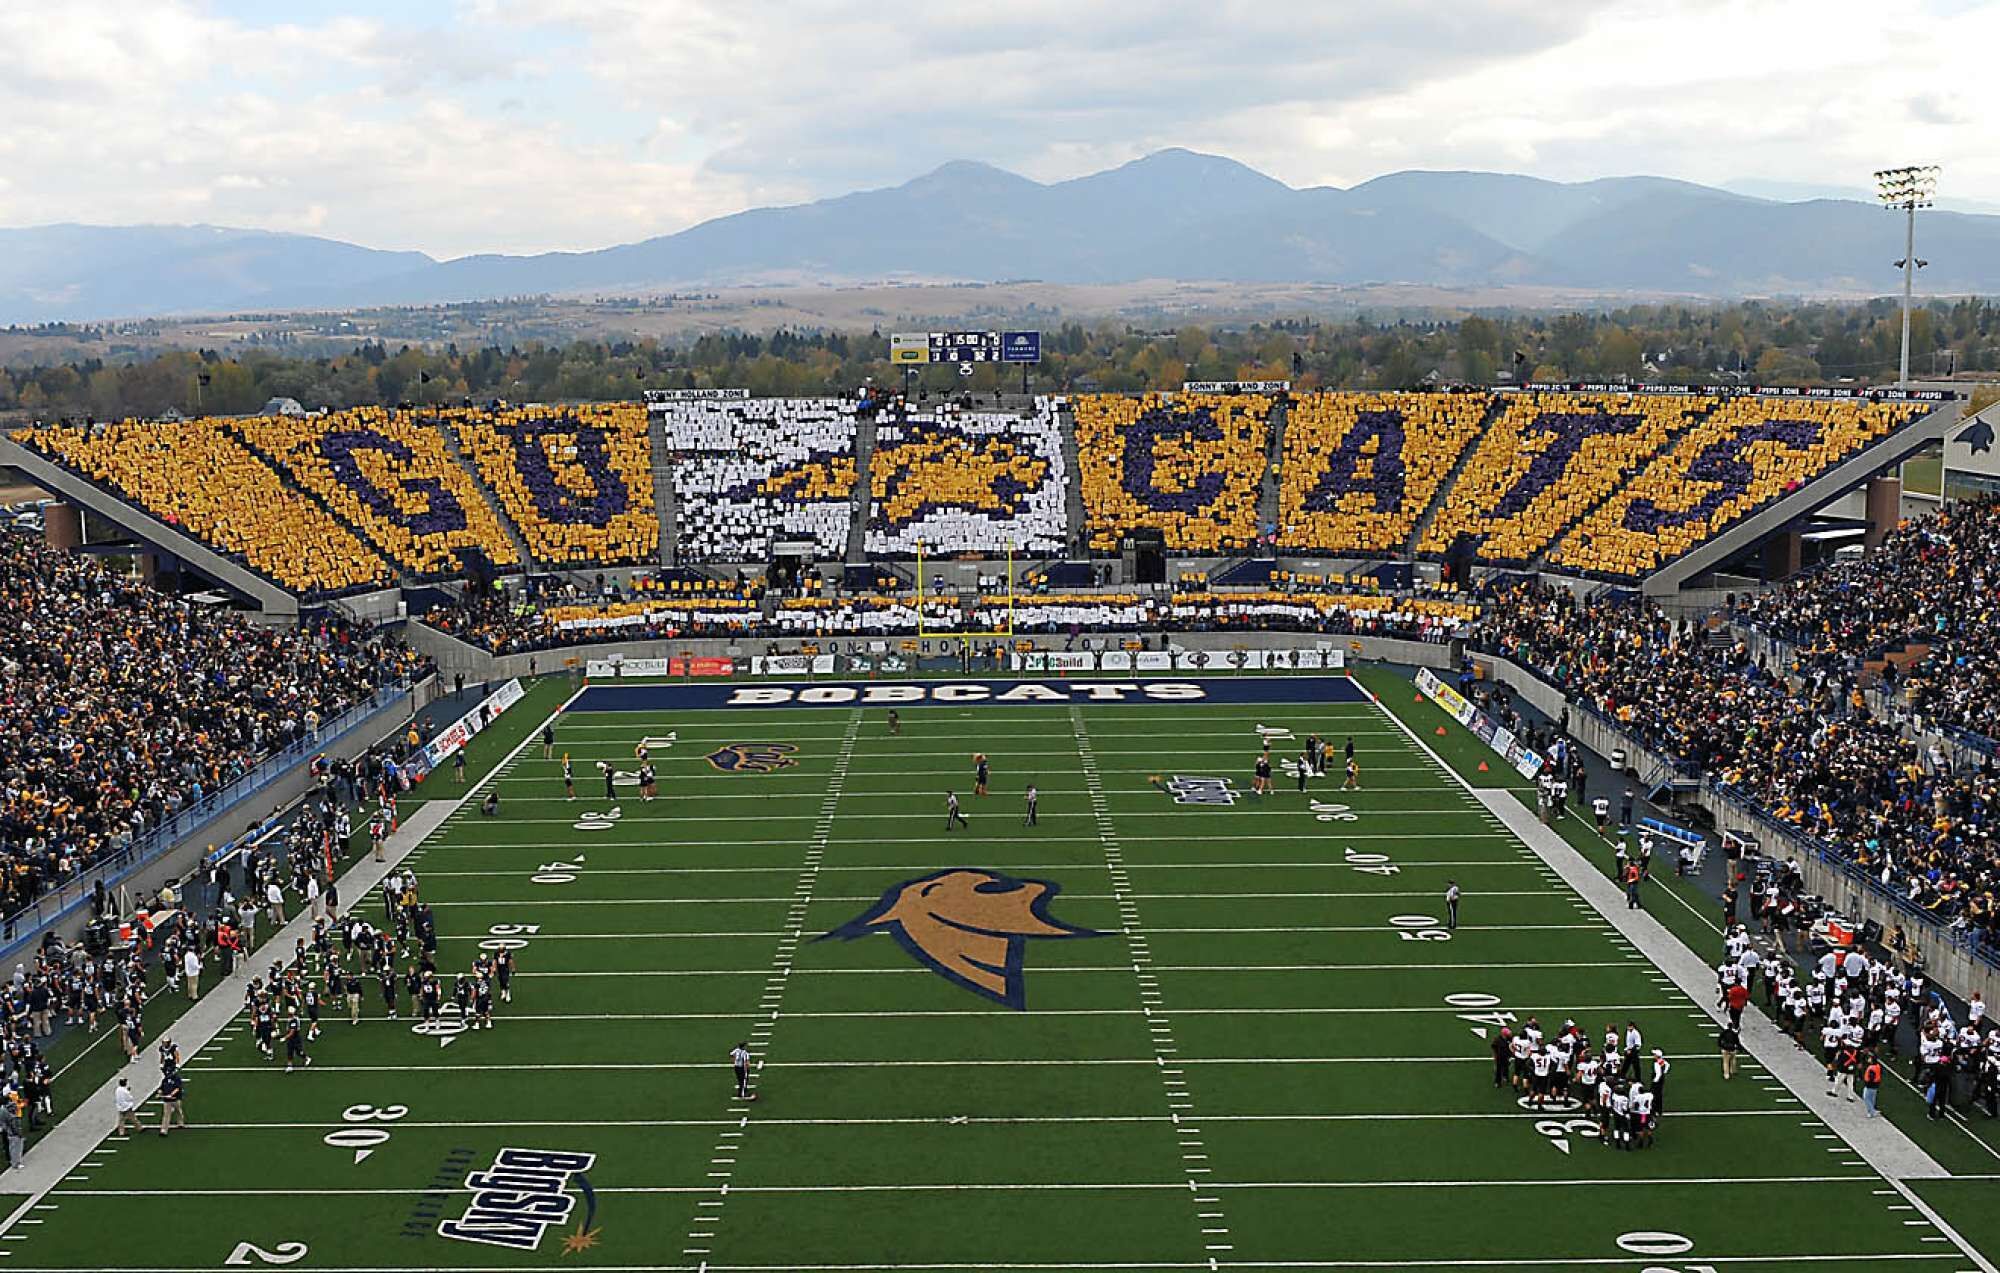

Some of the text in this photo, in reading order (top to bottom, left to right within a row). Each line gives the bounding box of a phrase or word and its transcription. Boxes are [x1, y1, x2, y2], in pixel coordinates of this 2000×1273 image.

[1221, 382, 1259, 390] HOAND
[1782, 387, 1799, 395] ZONE
[1122, 409, 1822, 532] CATS
[1065, 638, 1127, 652] ZOE
[727, 682, 1206, 703] BOBCATS
[478, 924, 541, 950] 50
[1389, 916, 1451, 941] 50
[1444, 993, 1518, 1026] 40
[324, 1104, 408, 1147] 30
